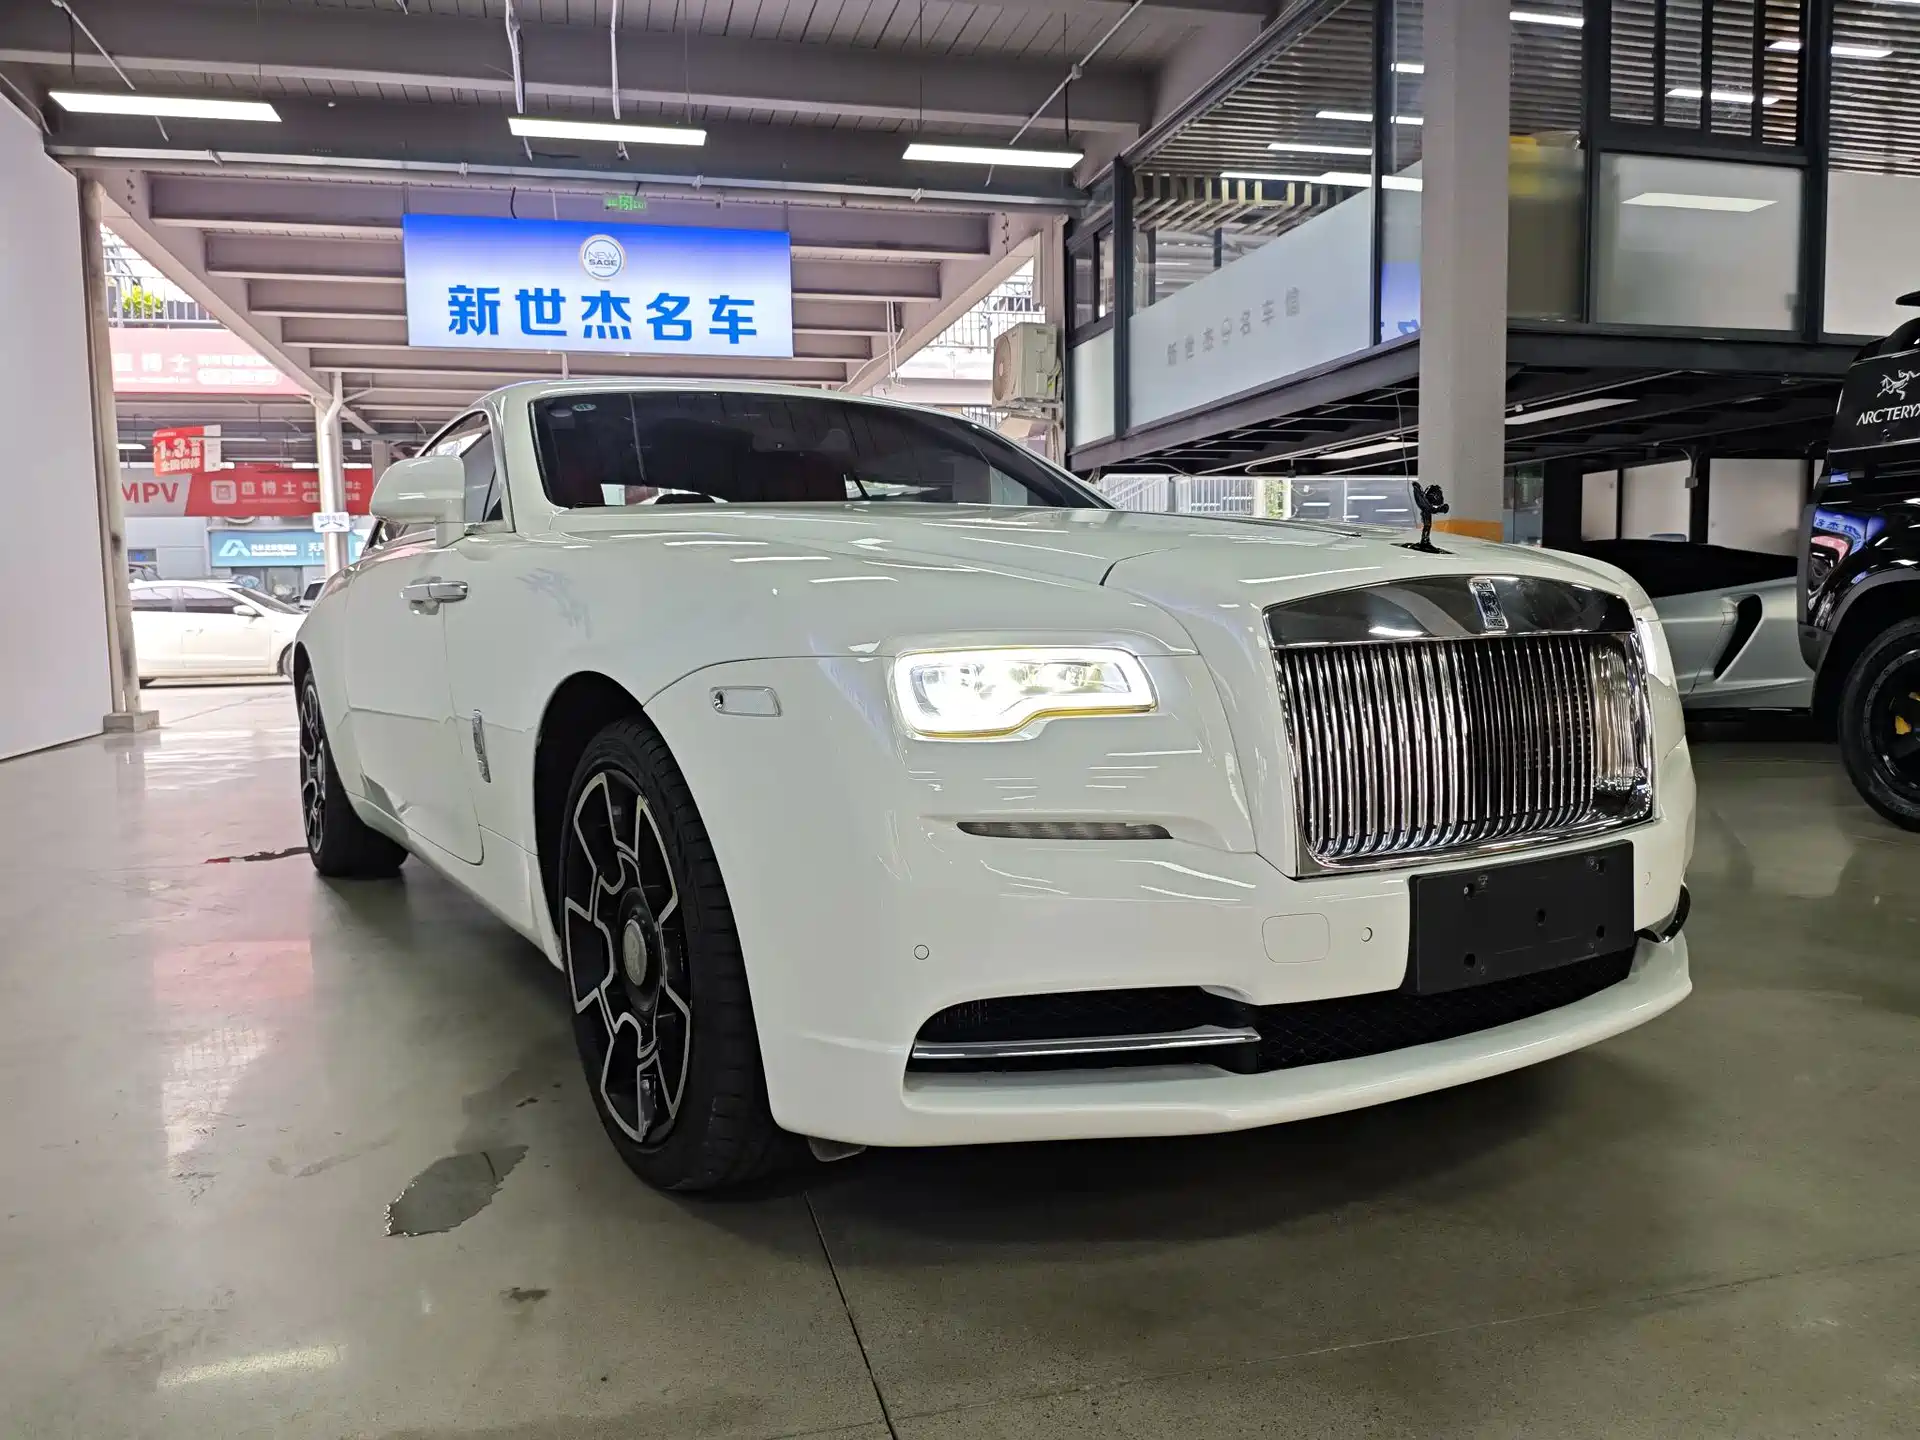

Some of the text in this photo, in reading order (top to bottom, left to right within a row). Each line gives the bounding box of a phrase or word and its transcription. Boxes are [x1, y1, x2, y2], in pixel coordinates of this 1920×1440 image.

[588, 250, 617, 260] NEW
[588, 259, 618, 267] SAGE
[448, 284, 757, 344] 新世杰名车
[121, 482, 179, 504] MPV
